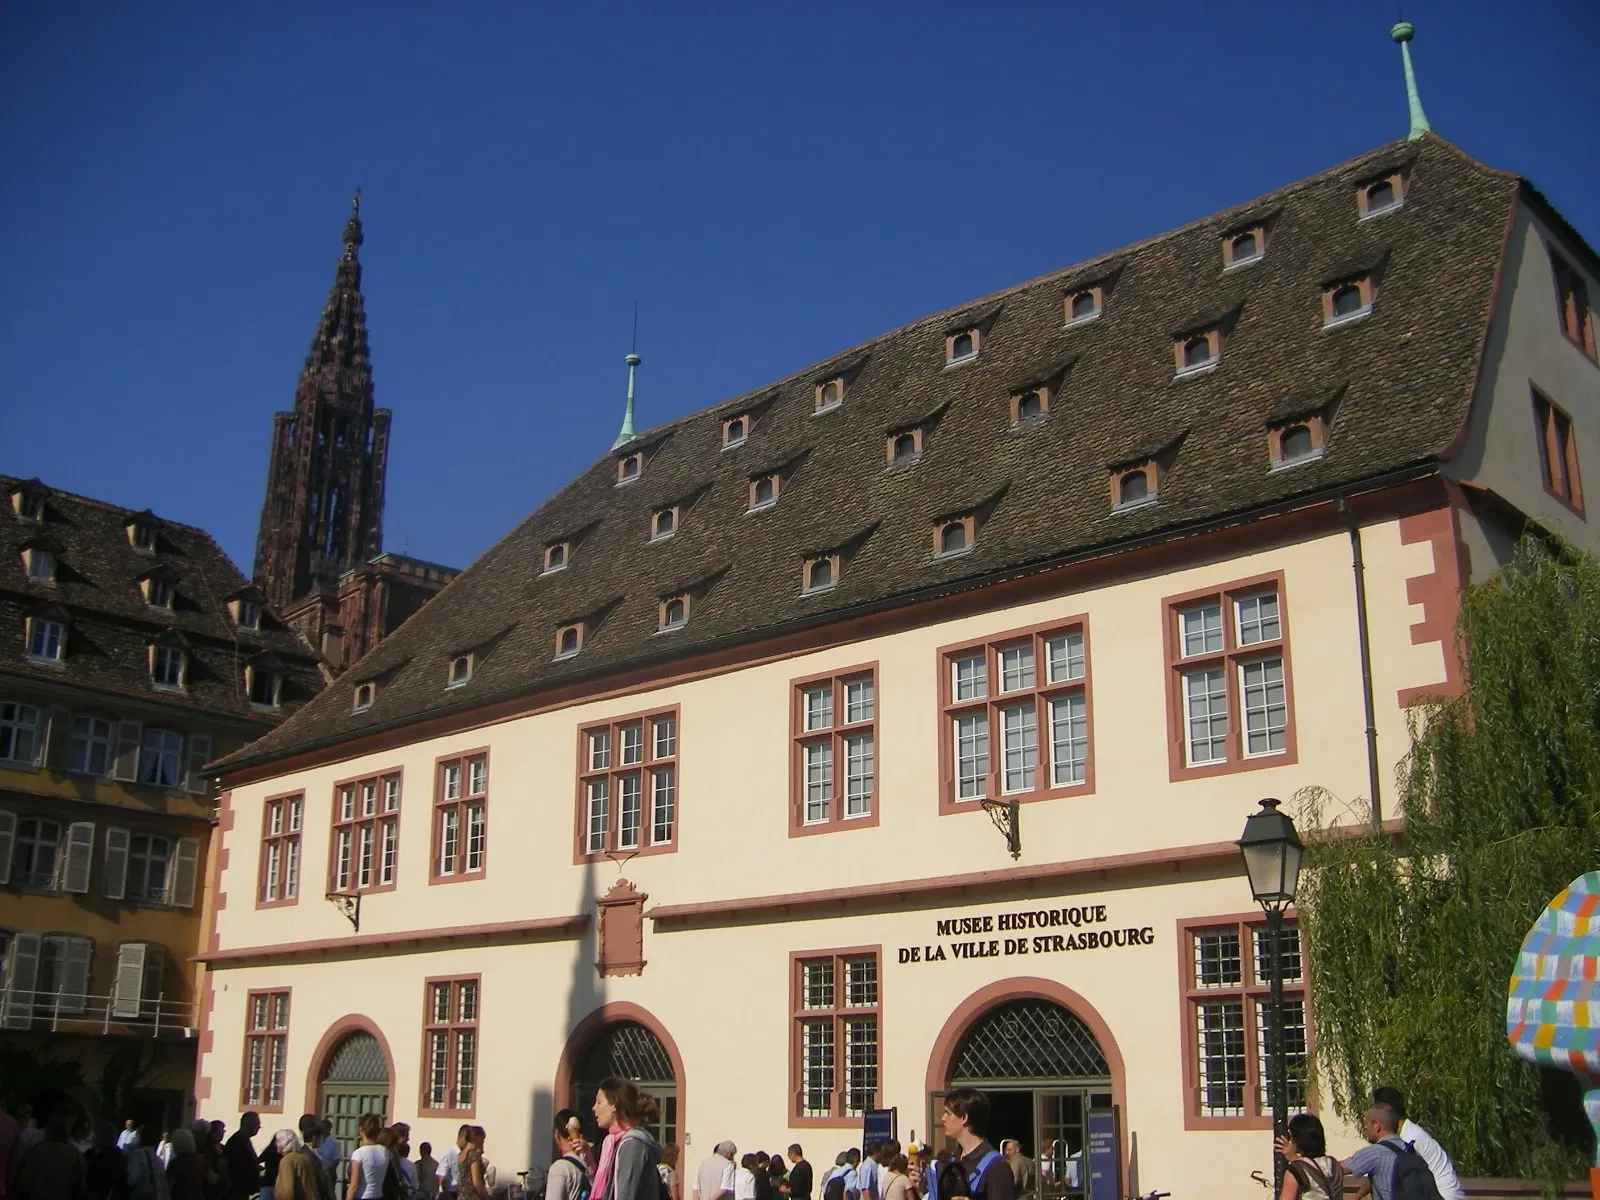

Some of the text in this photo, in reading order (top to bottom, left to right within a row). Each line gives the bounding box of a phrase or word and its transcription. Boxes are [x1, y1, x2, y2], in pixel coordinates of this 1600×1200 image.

[936, 904, 1108, 937] MUSEE HISTORIQUE
[898, 926, 1155, 964] DE LA VILLE DE STRASBOURG
